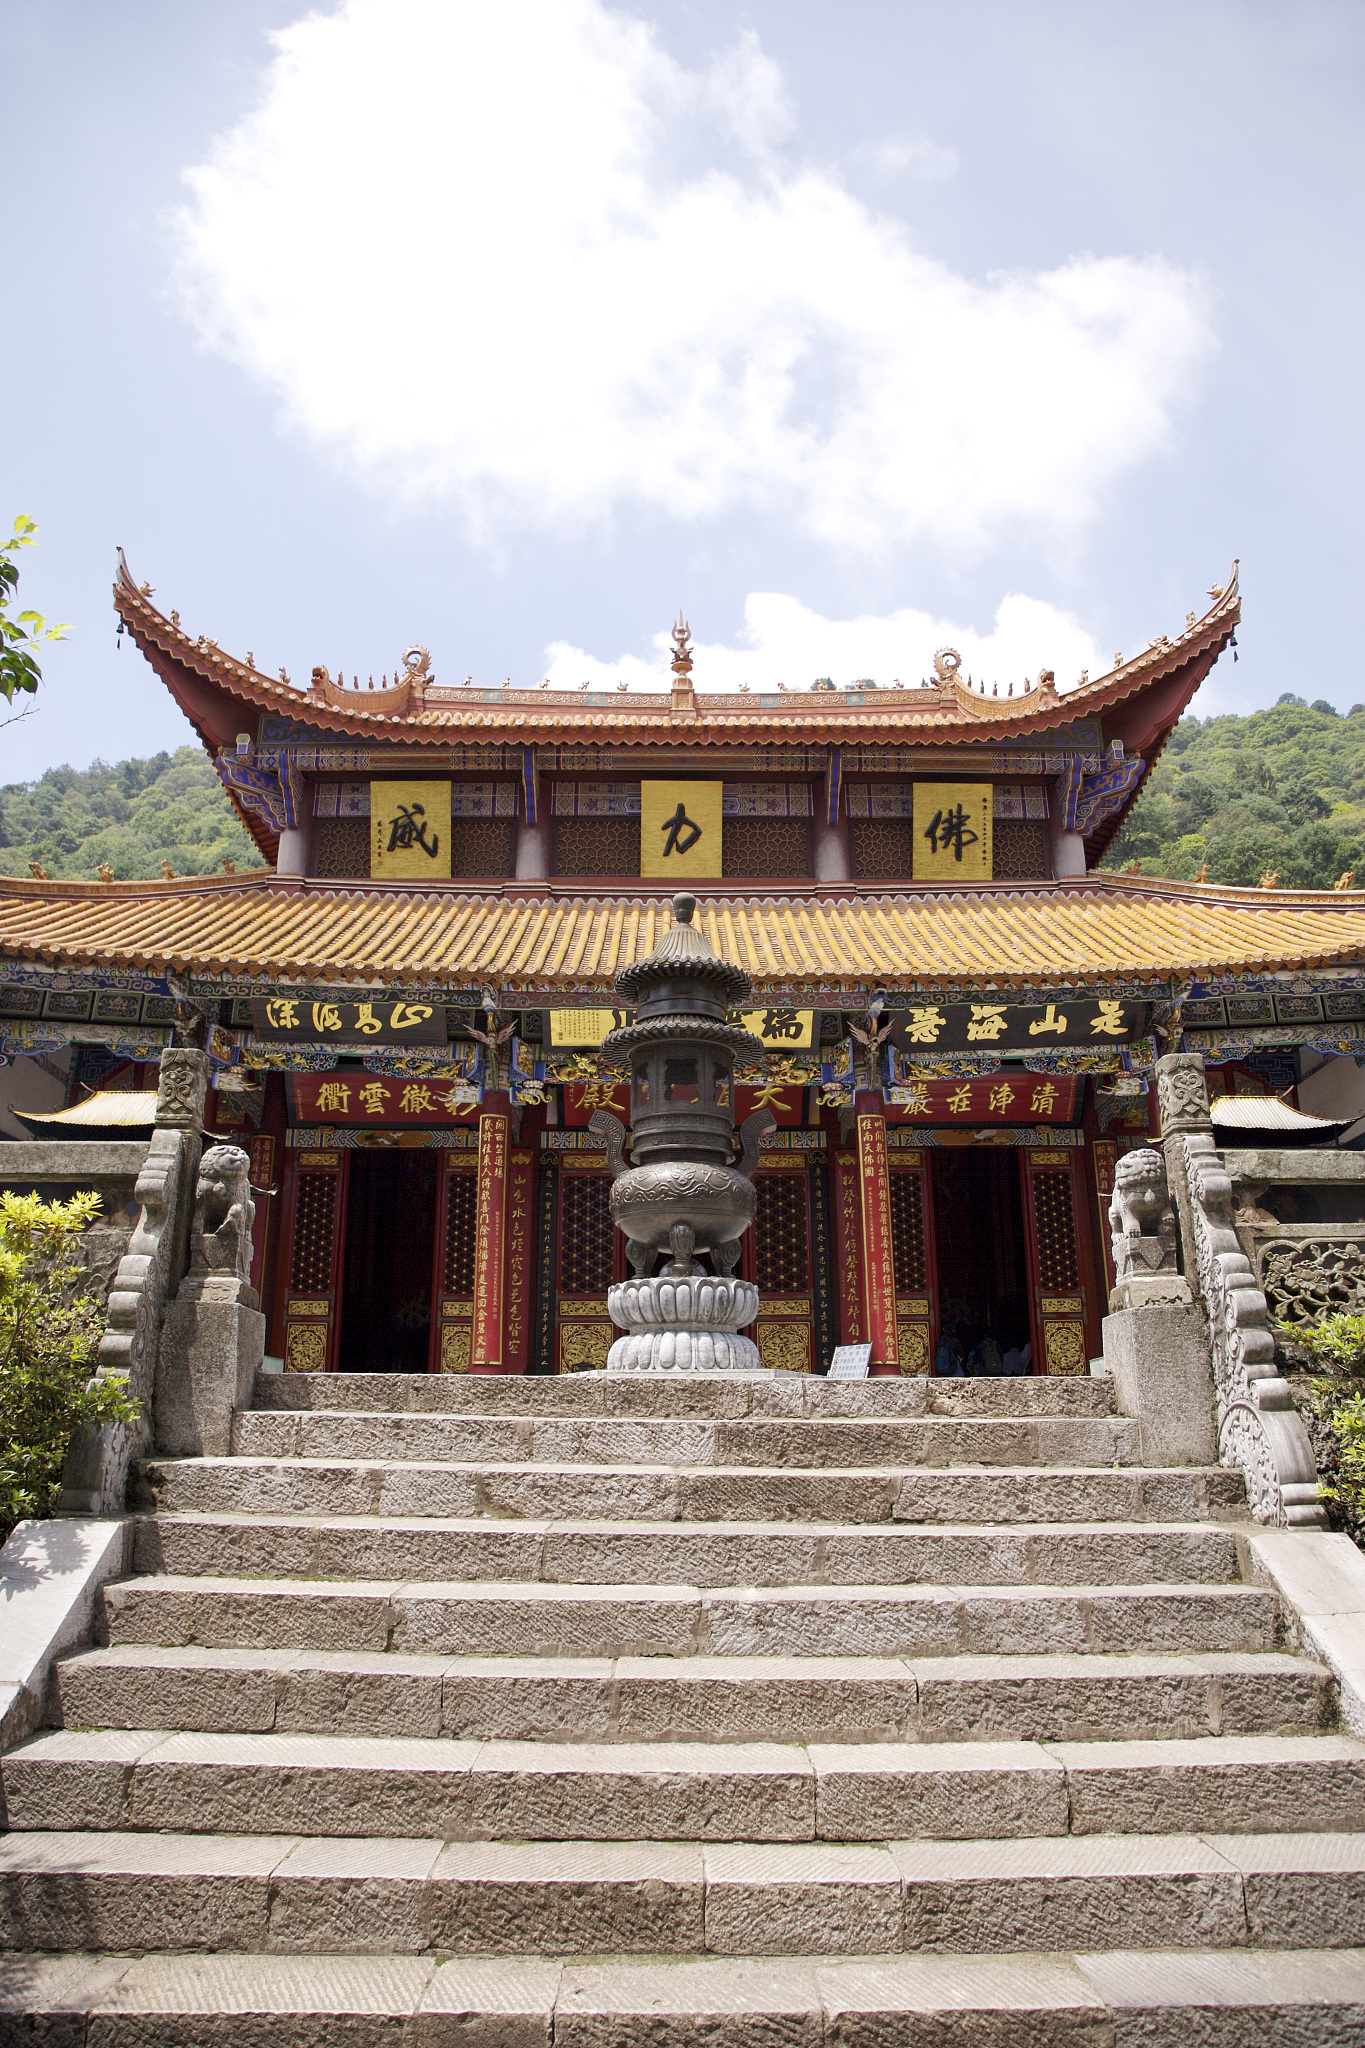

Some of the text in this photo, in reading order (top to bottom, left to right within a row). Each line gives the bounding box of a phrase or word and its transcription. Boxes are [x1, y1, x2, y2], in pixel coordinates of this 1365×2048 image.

[387, 802, 438, 858] 威
[662, 803, 703, 857] 力
[925, 803, 978, 861] 佛
